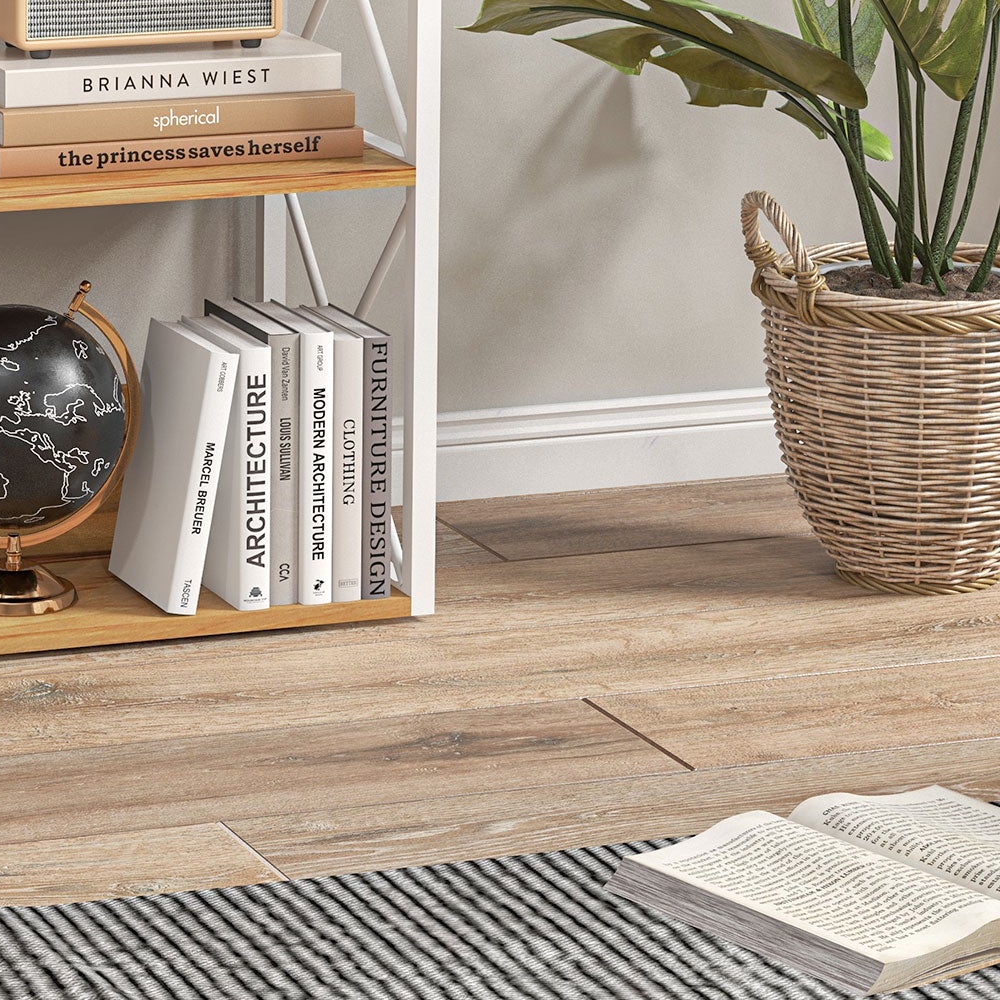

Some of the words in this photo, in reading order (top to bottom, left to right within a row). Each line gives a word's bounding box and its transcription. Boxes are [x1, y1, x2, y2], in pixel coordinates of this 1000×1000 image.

[83, 73, 190, 93] BRIANNA
[202, 68, 270, 86] WIEST
[153, 105, 220, 131] spherical
[58, 149, 94, 167] the
[96, 146, 186, 169] princess
[188, 144, 245, 159] saves
[247, 136, 321, 156] herself
[281, 346, 291, 364] David
[281, 365, 290, 378] Van
[279, 417, 291, 441] LOUIS
[312, 387, 326, 449] MODERN
[370, 342, 388, 494] FURNITURE
[200, 442, 216, 488] MARCEL
[246, 373, 267, 568] ARCHITECTURE
[279, 442, 291, 481] SULLIVAN
[342, 418, 356, 506] CLOTHING
[191, 490, 208, 536] BREUER
[312, 452, 326, 561] ARCHITECTURE
[369, 501, 386, 596] DESIGN
